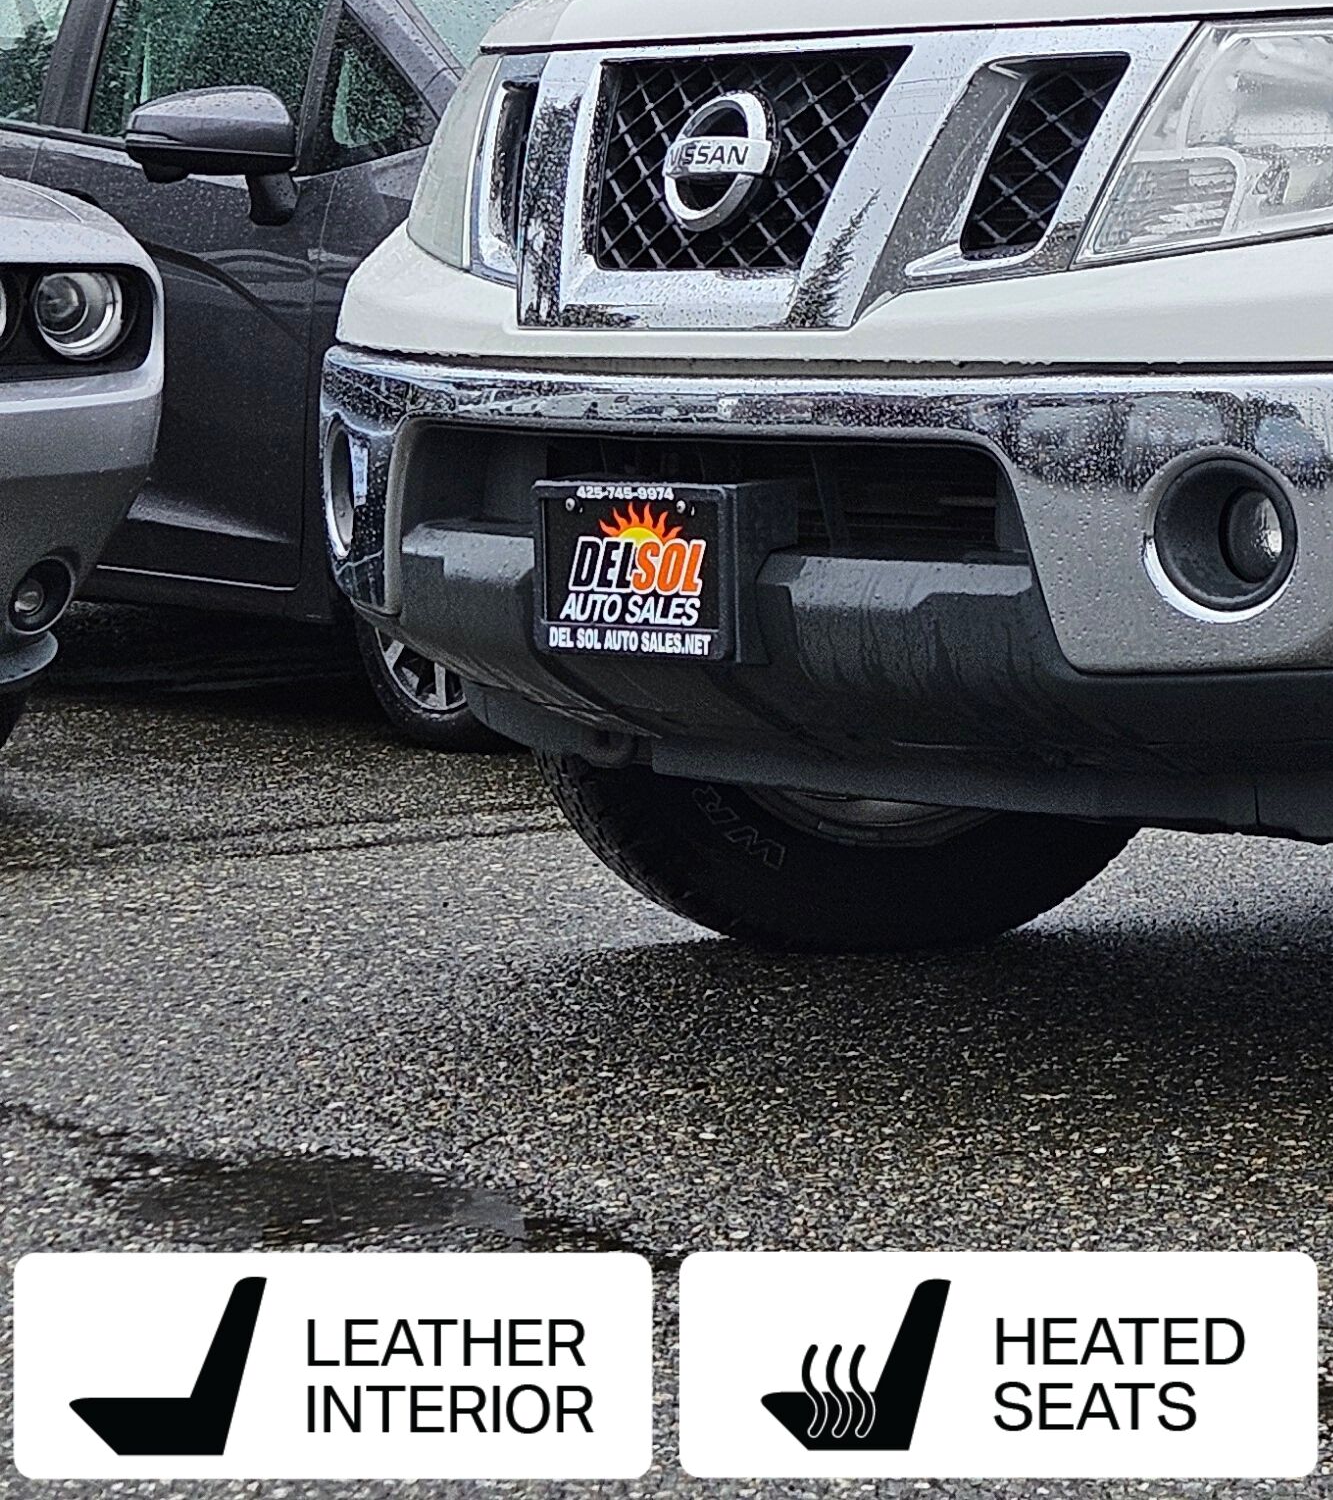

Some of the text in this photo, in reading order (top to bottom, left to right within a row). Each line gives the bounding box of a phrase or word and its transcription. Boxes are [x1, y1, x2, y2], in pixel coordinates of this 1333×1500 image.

[575, 485, 675, 501] 425-745-9974
[559, 592, 701, 627] AUTO SALES
[549, 626, 712, 656] DEL SOL AUTO SALES.NET
